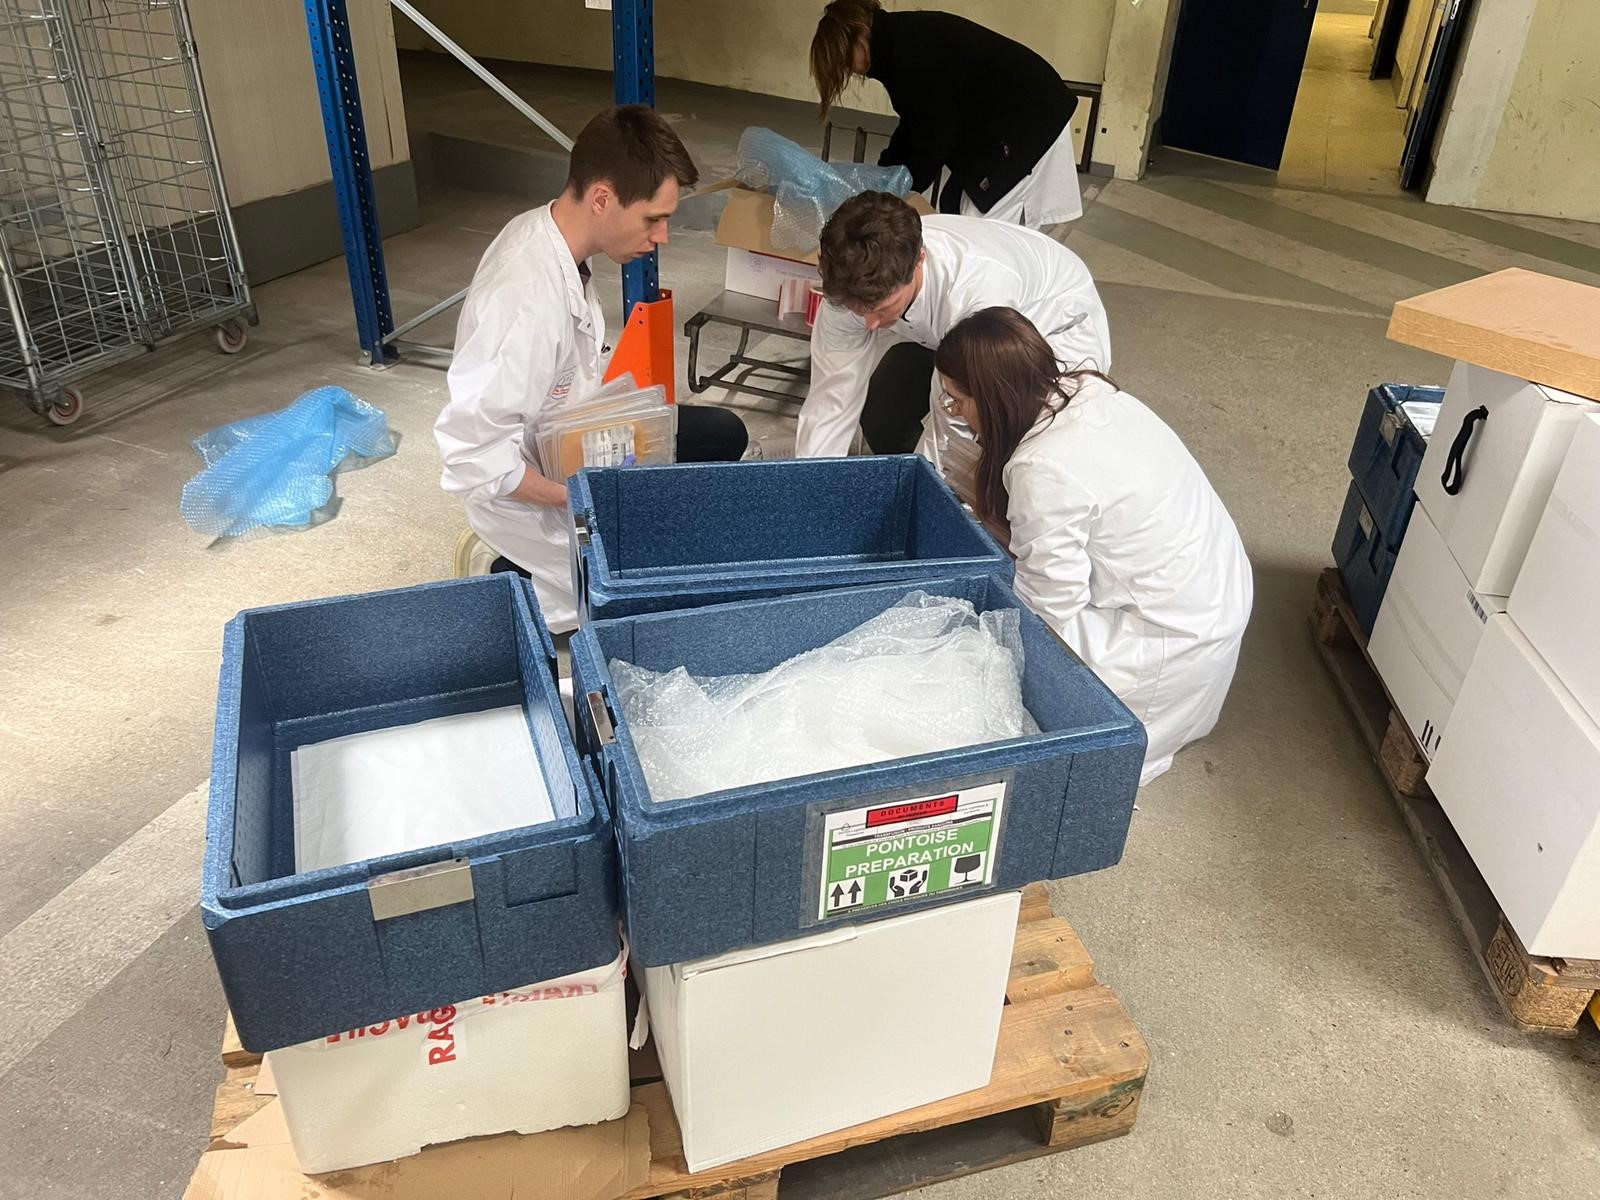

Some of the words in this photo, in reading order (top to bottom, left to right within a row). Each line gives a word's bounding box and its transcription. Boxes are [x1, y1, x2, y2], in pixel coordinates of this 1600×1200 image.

[880, 800, 945, 817] DOCUMENTS
[866, 828, 958, 856] PONTOISE
[845, 841, 974, 878] PREPARATION
